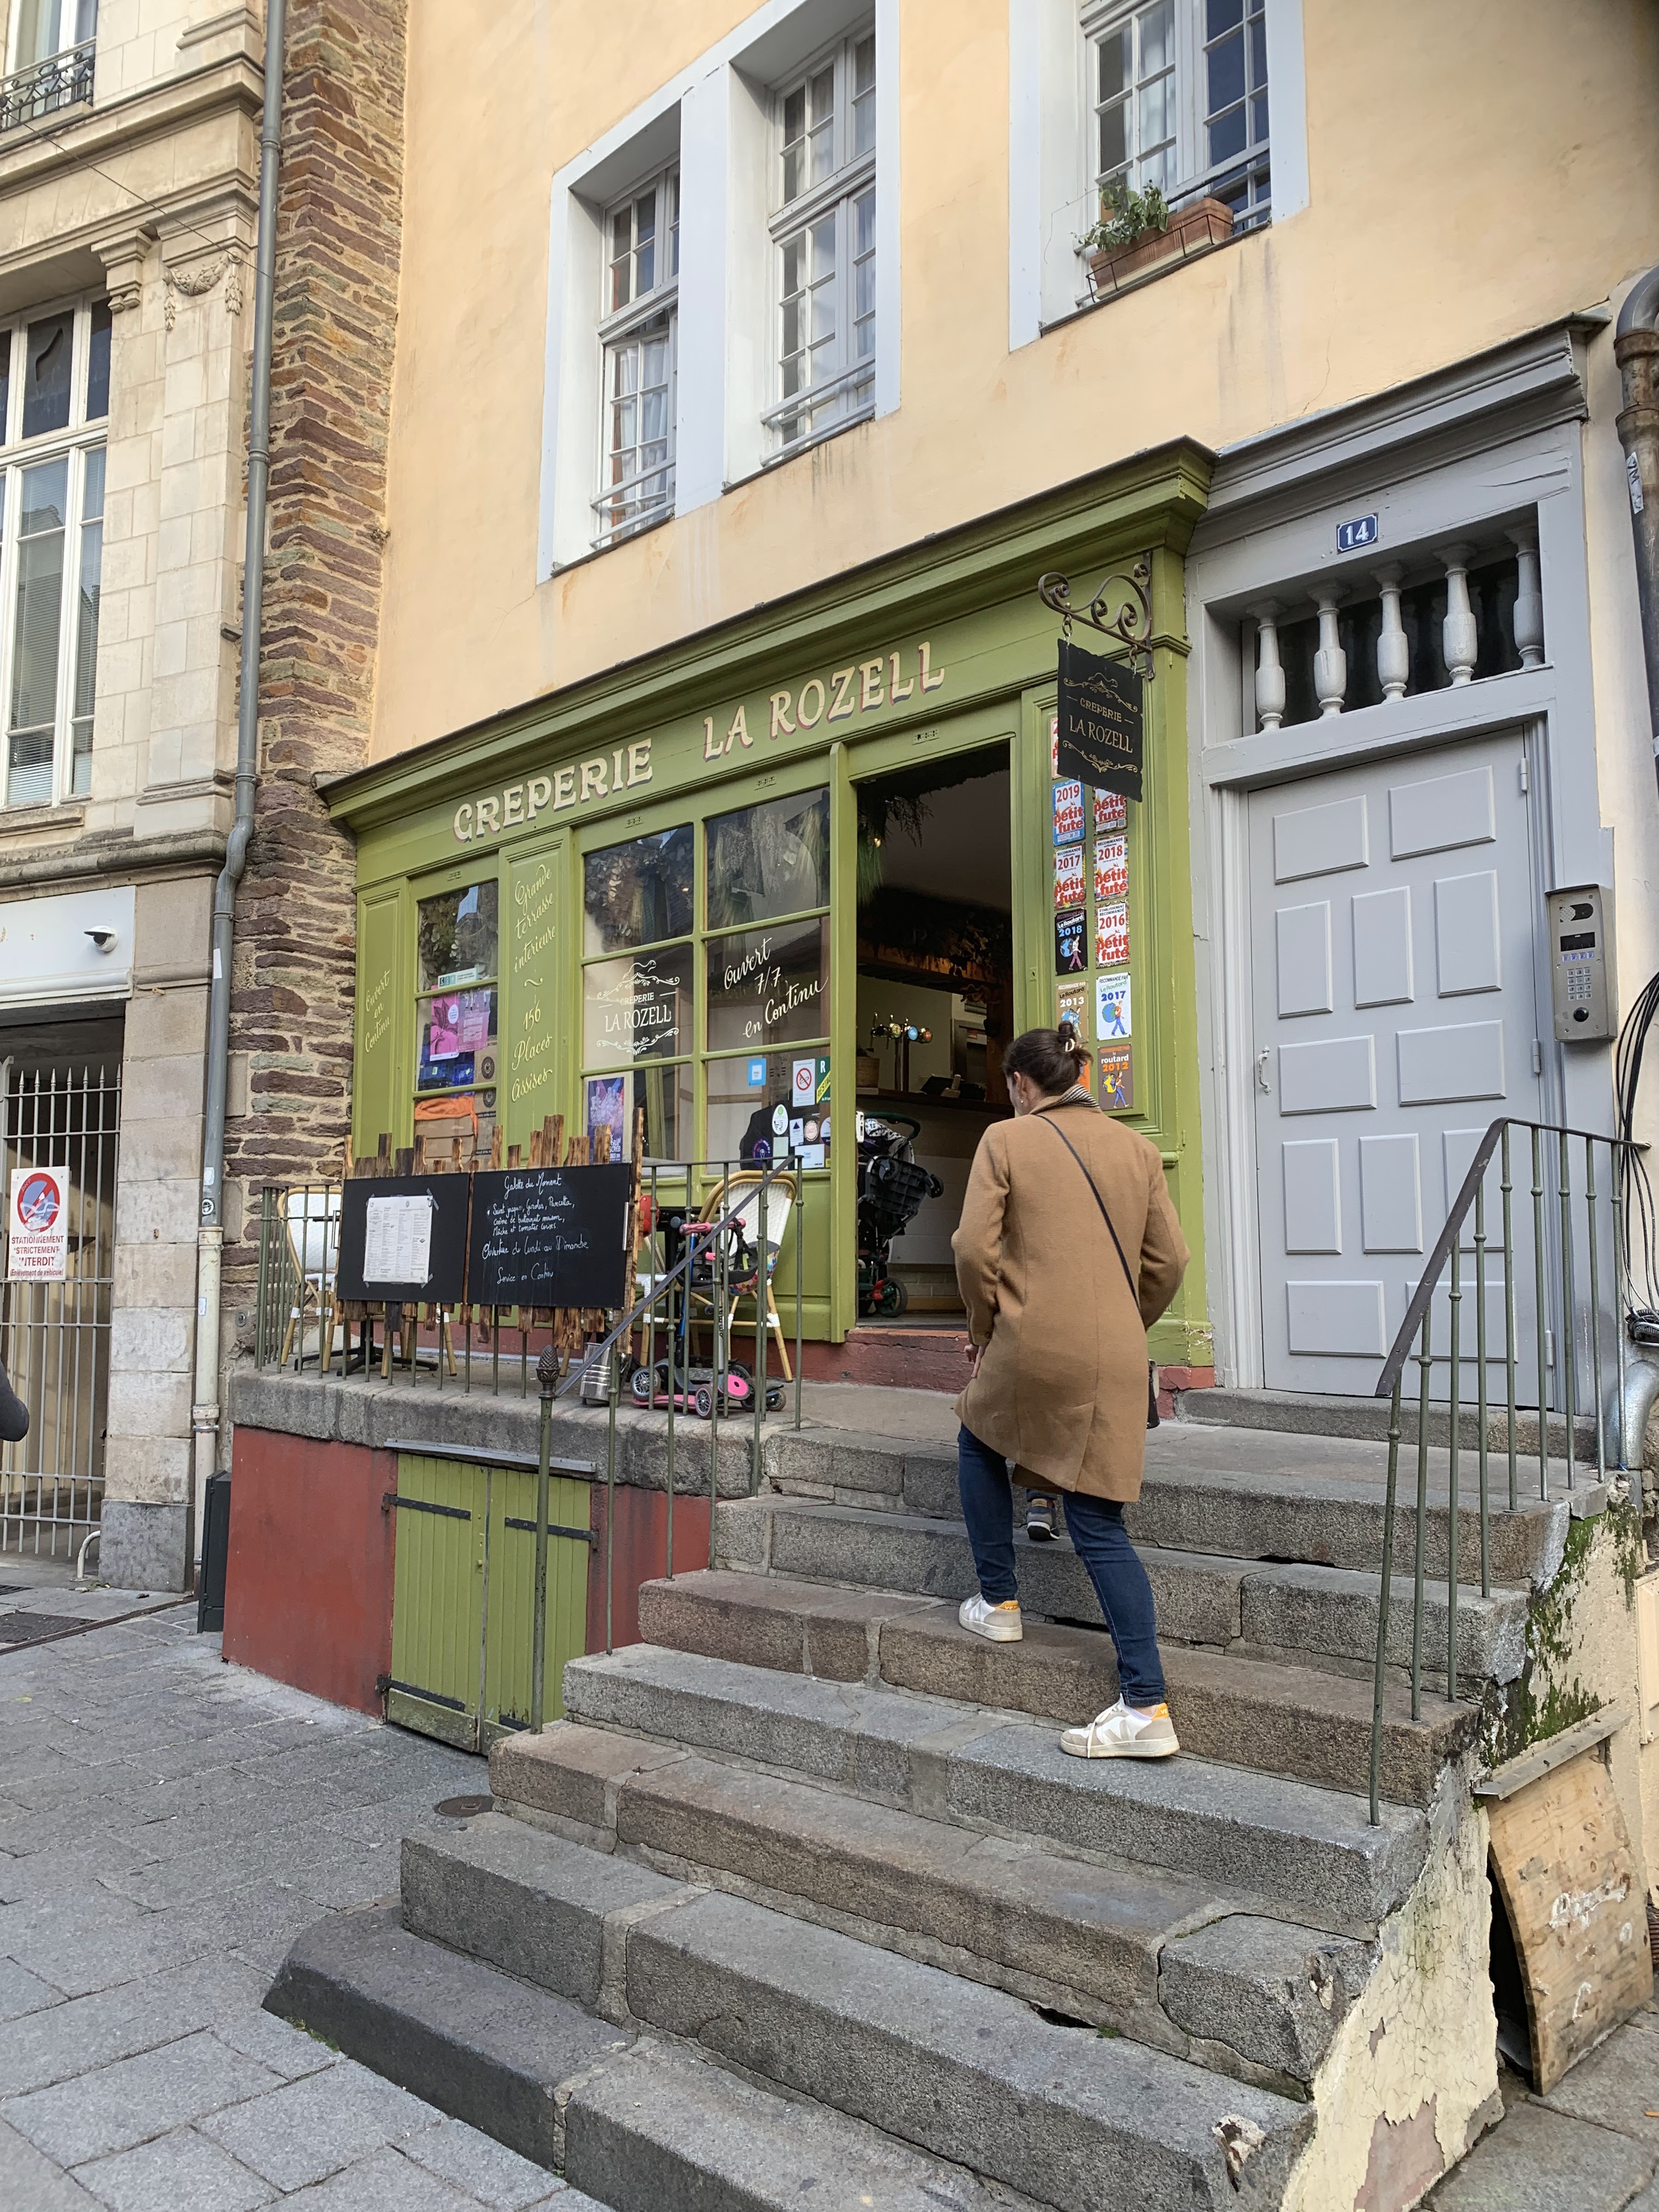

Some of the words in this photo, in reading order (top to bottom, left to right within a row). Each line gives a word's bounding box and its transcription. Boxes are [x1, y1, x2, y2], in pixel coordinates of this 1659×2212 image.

[1346, 521, 1369, 545] 14
[1080, 698, 1122, 723] CREPERIE
[453, 737, 653, 844] CREPERIE
[703, 705, 754, 762] LA
[769, 641, 945, 740] ROZELL
[1069, 715, 1086, 737] LA
[1088, 721, 1133, 753] ROZELL
[1057, 785, 1080, 803] 2019
[1094, 795, 1125, 815] petit
[1053, 806, 1083, 827] petit
[1058, 855, 1080, 870] 2017
[1098, 845, 1122, 861] 2018
[1054, 877, 1085, 897] petit
[1095, 868, 1127, 888] petit
[515, 864, 552, 916] Grande
[514, 893, 554, 940] terrasse
[1063, 914, 1084, 926] Routard
[1099, 913, 1125, 930] 2016
[1059, 925, 1082, 938] 2018
[514, 926, 556, 973] interieure
[1097, 934, 1128, 953] petit
[724, 937, 772, 990] Ouvert
[754, 966, 781, 995] 7/7
[1106, 979, 1127, 991] Routard
[366, 969, 391, 1012] Ouvert
[620, 992, 654, 1006] CREPERIE
[1065, 987, 1084, 997] Routard
[1101, 990, 1126, 1002] 2017
[373, 1003, 384, 1019] en
[742, 1020, 763, 1038] en
[765, 976, 829, 1024] Continu
[1060, 996, 1085, 1008] 2013
[523, 1000, 541, 1032] 156
[605, 1014, 621, 1032] LA
[624, 1005, 672, 1030] ROZELL
[365, 1017, 391, 1053] Continu
[511, 1032, 552, 1070] Places
[1101, 1054, 1129, 1064] routard
[1103, 1062, 1129, 1073] 2012
[511, 1068, 553, 1103] Assises
[504, 1175, 524, 1200] Galette
[525, 1178, 534, 1189] du
[536, 1172, 562, 1195] Moment
[493, 1203, 505, 1215] Saint
[510, 1215, 516, 1223] de
[510, 1224, 517, 1233] et
[12, 1235, 64, 1244] STATIONNEMENT
[512, 1242, 521, 1255] du
[556, 1234, 589, 1251] Dimanche
[16, 1246, 59, 1254] STRICTEMENT
[19, 1256, 55, 1266] NTERDIT
[497, 1267, 516, 1284] Service
